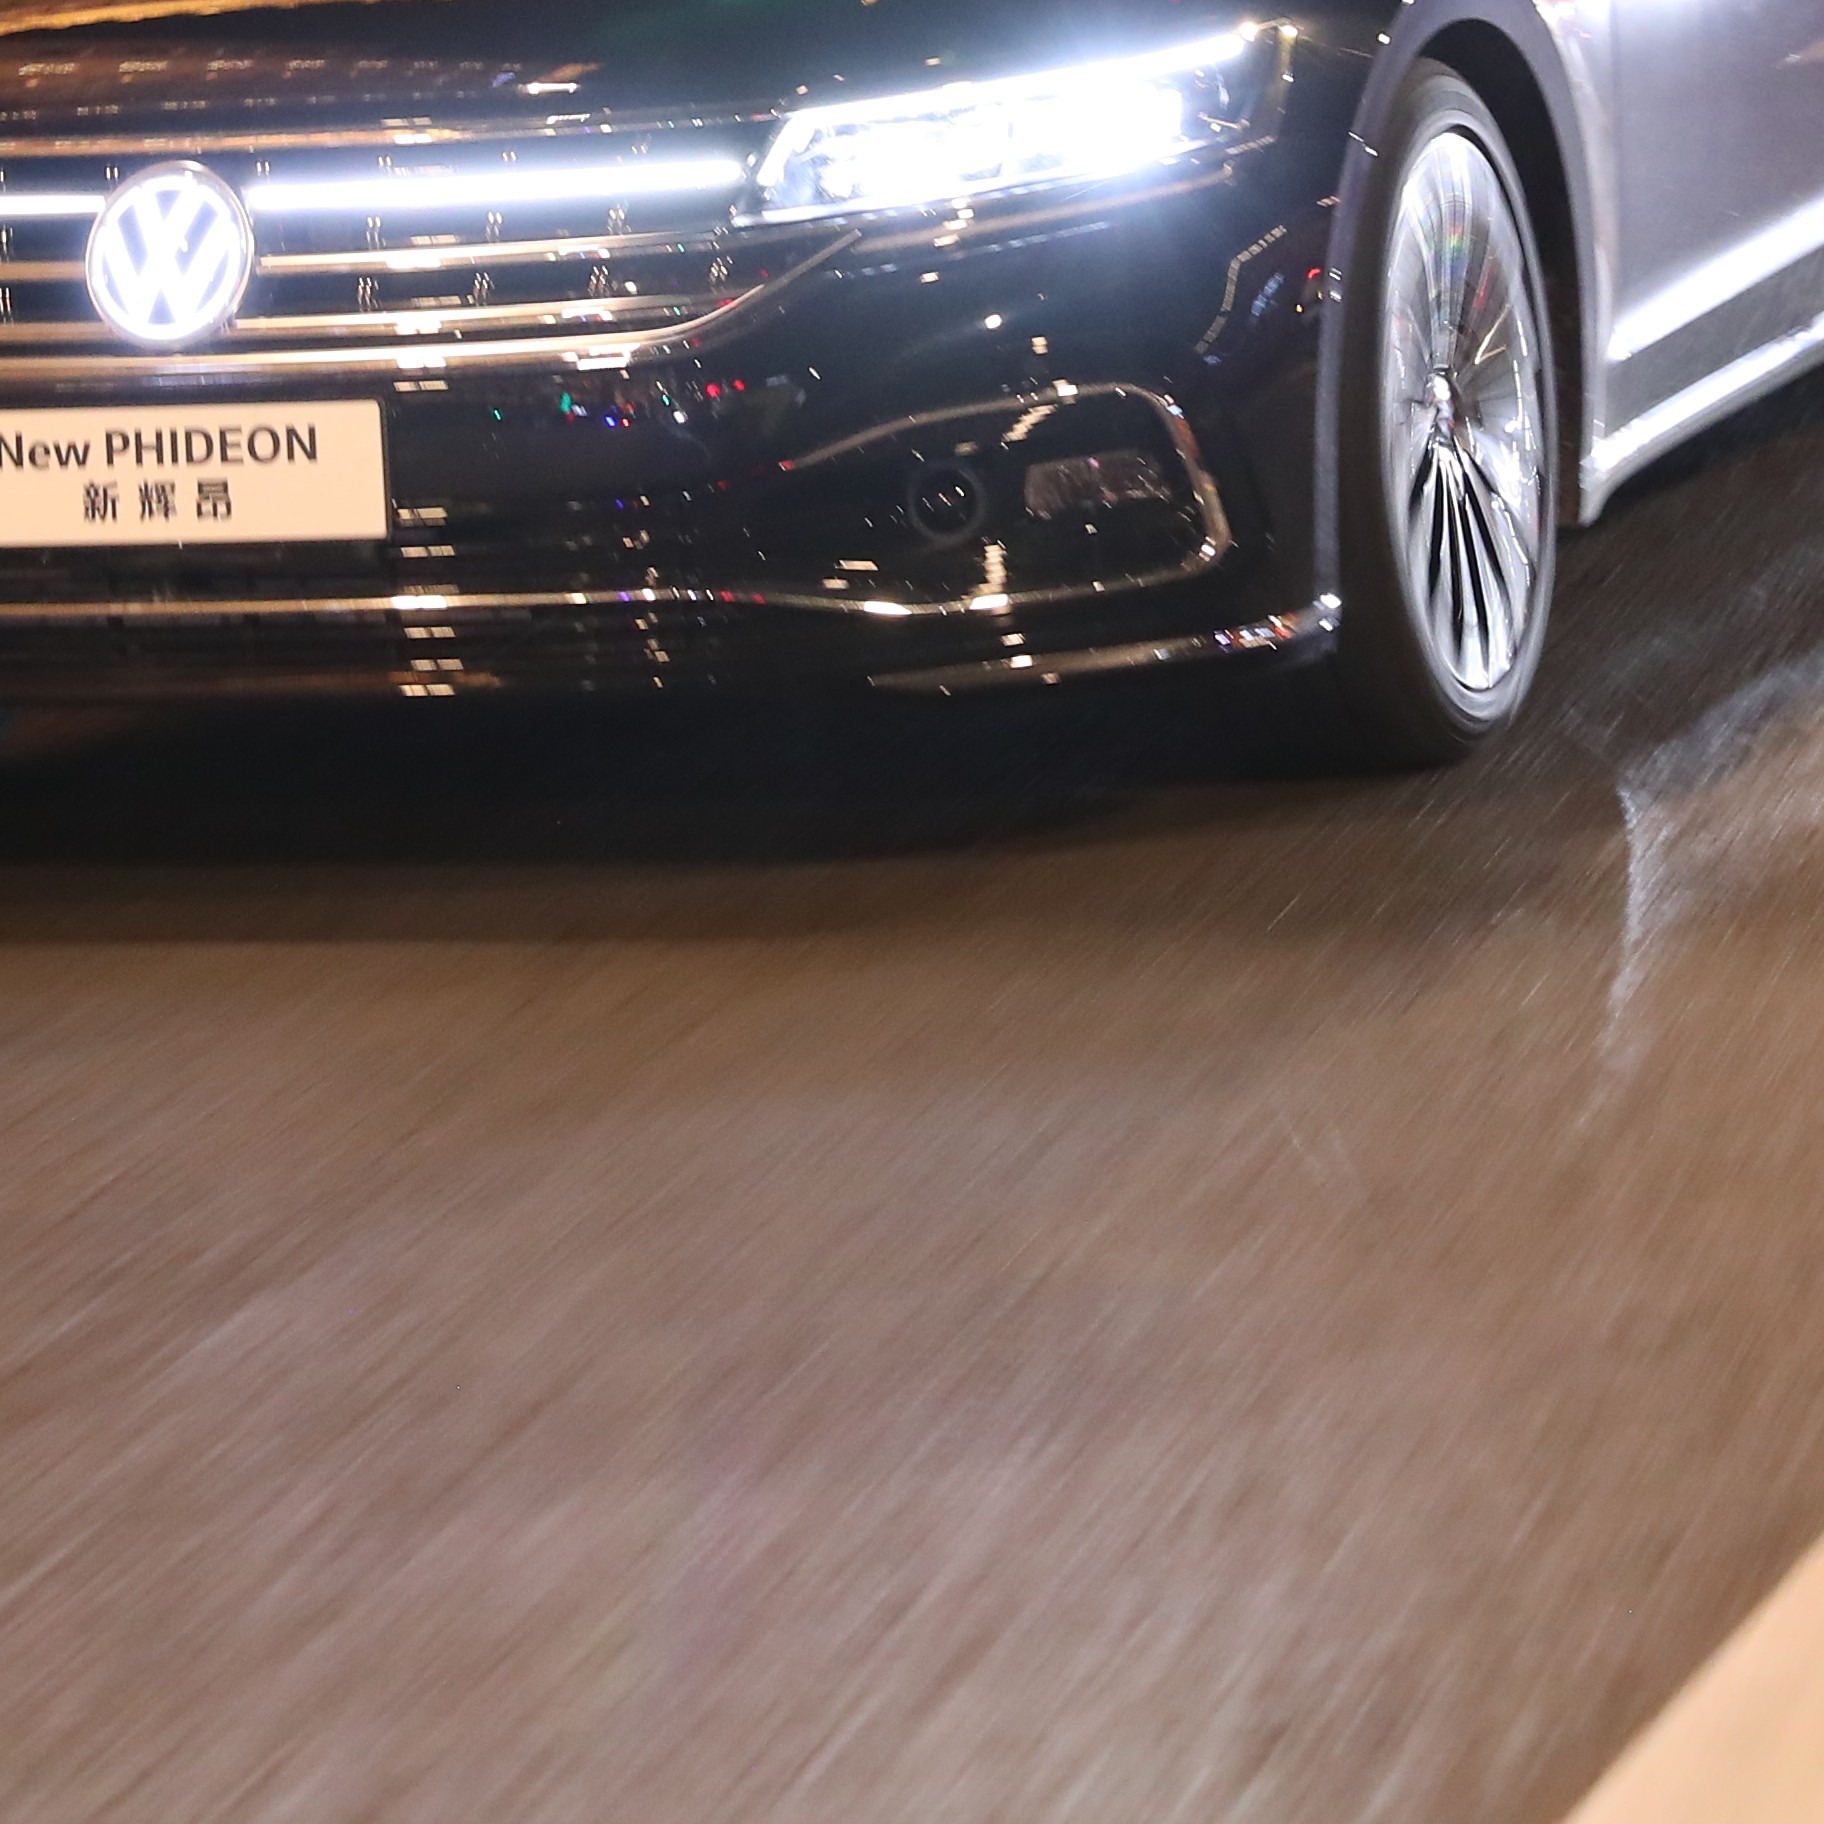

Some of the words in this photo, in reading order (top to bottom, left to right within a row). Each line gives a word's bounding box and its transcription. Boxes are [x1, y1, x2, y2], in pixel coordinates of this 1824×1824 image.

[105, 423, 319, 467] PHIDEON
[83, 479, 233, 523] 新辉昂
